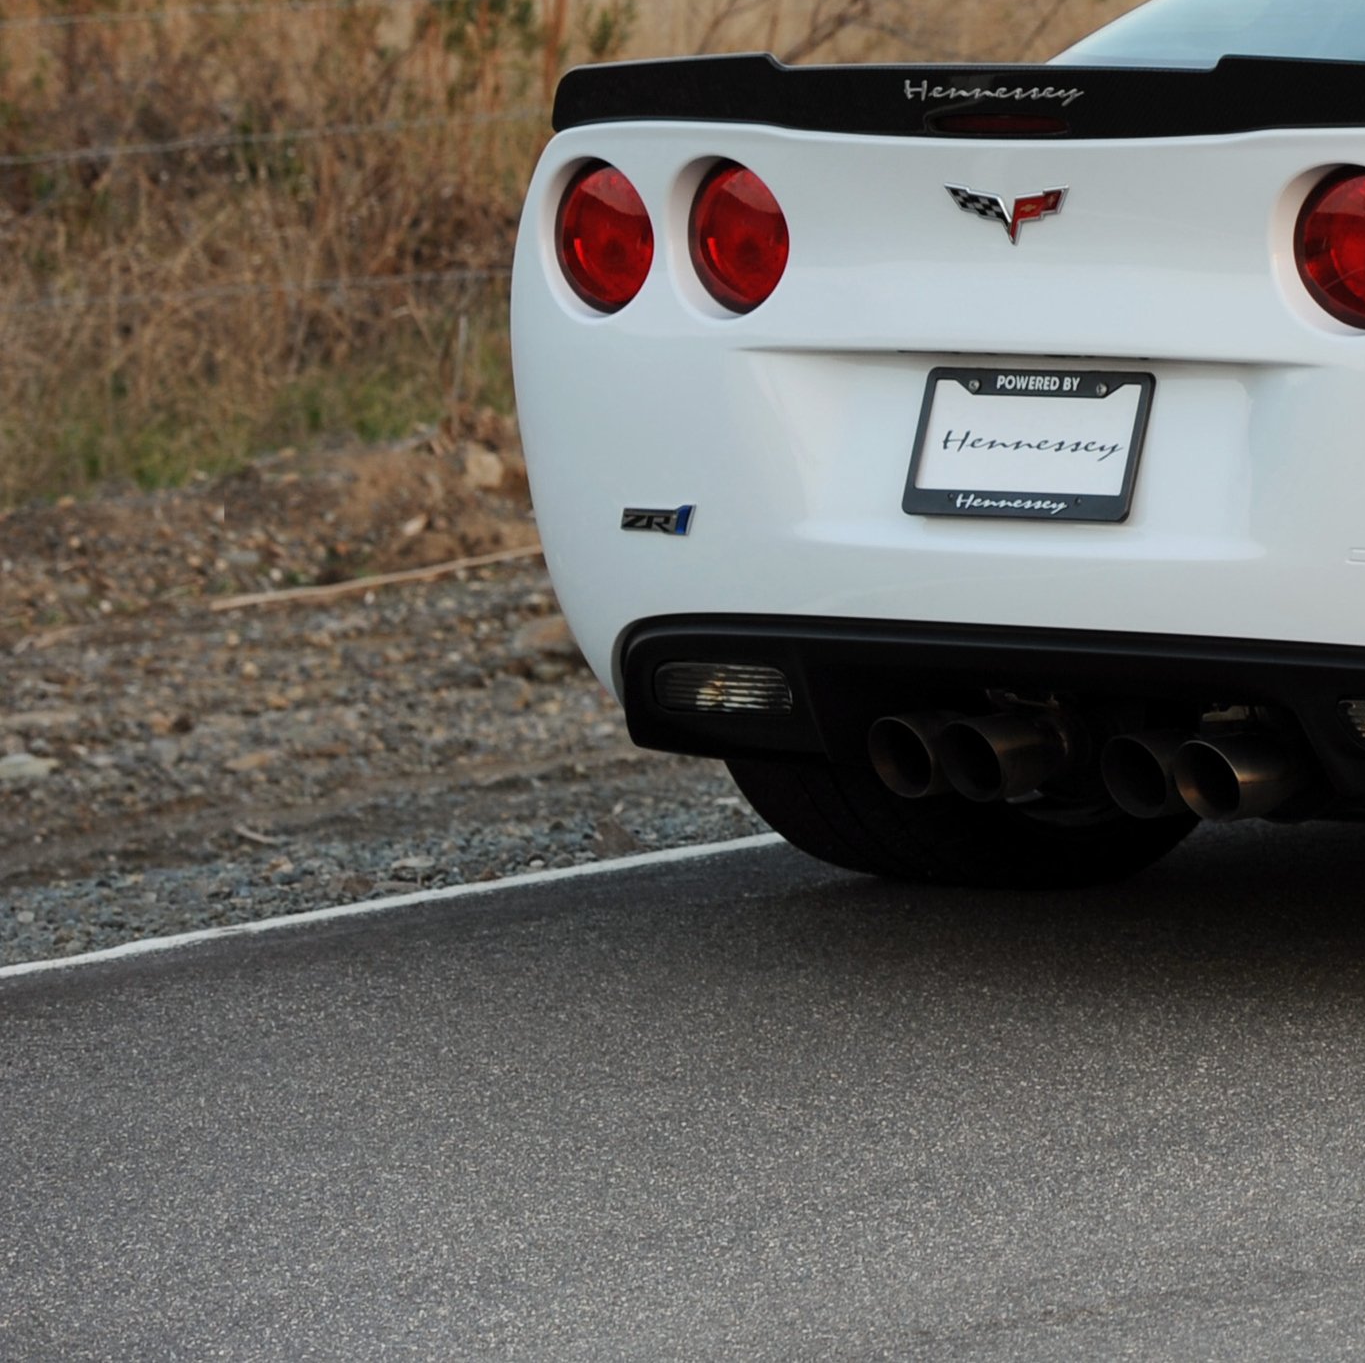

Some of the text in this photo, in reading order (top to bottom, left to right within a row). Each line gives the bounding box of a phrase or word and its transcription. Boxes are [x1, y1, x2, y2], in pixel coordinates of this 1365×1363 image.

[904, 79, 1085, 107] Hennessey
[996, 374, 1081, 392] POWERED BY
[941, 429, 1124, 462] Hennessey
[955, 492, 1068, 515] Hennessey
[621, 504, 697, 536] ZR1
